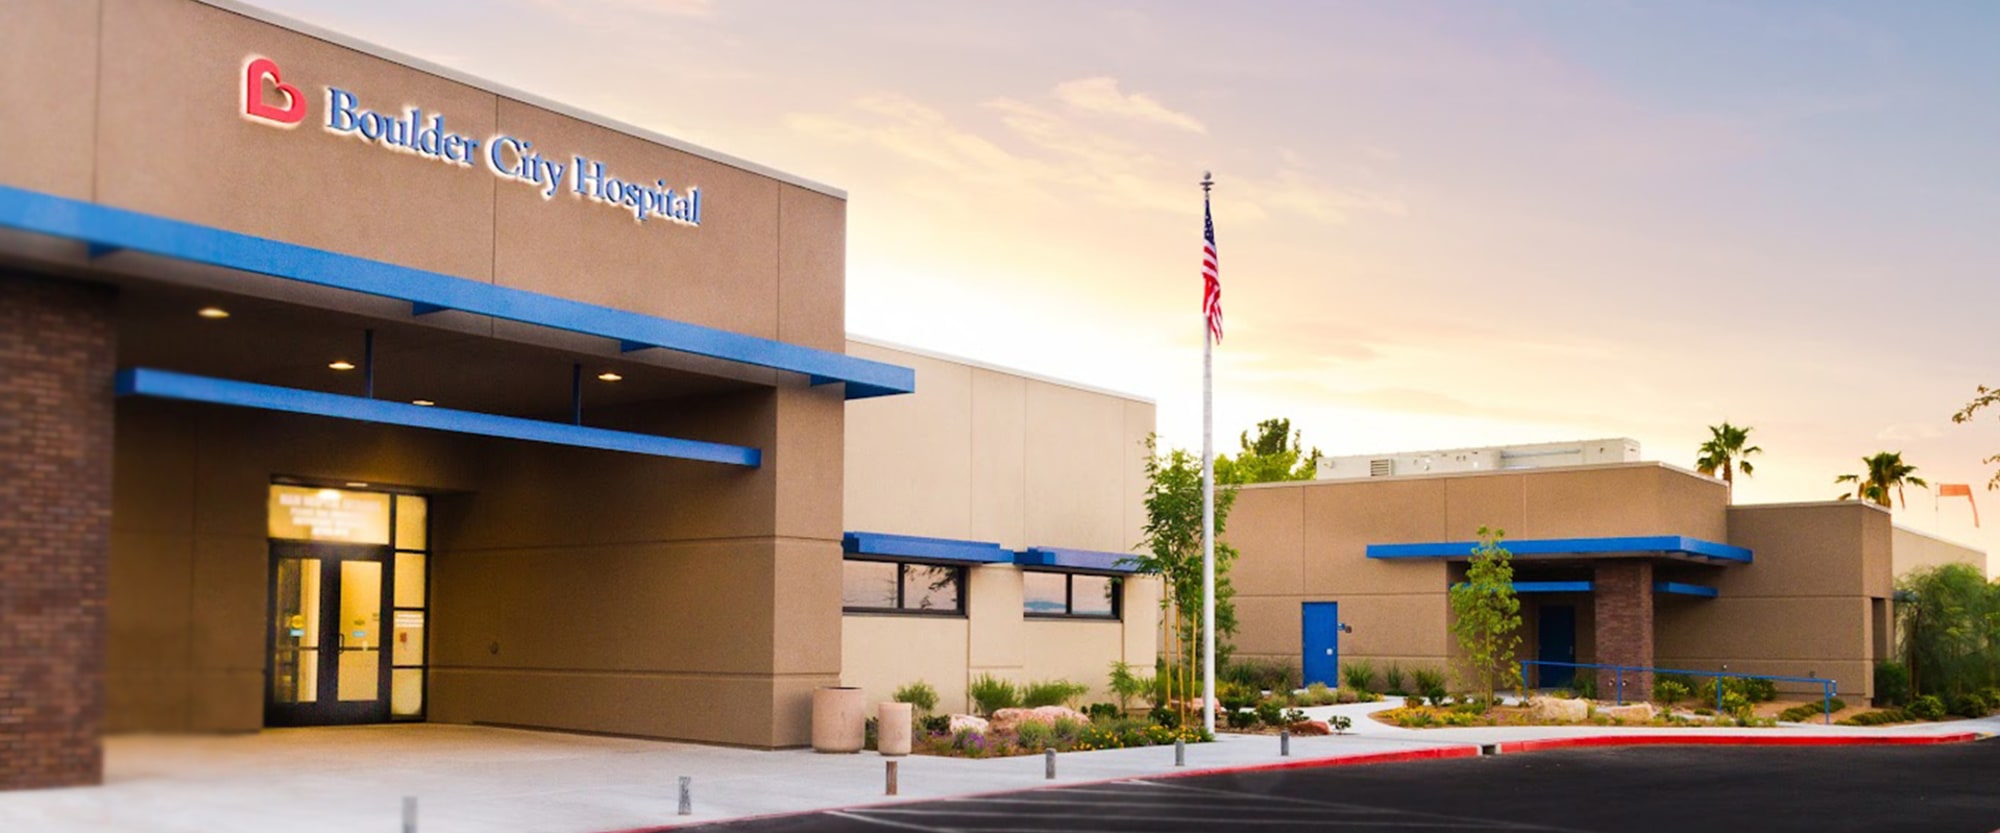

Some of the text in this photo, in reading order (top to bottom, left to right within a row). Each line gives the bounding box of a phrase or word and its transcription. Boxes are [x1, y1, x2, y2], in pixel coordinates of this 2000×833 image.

[327, 87, 701, 224] Boulder City Hospital
